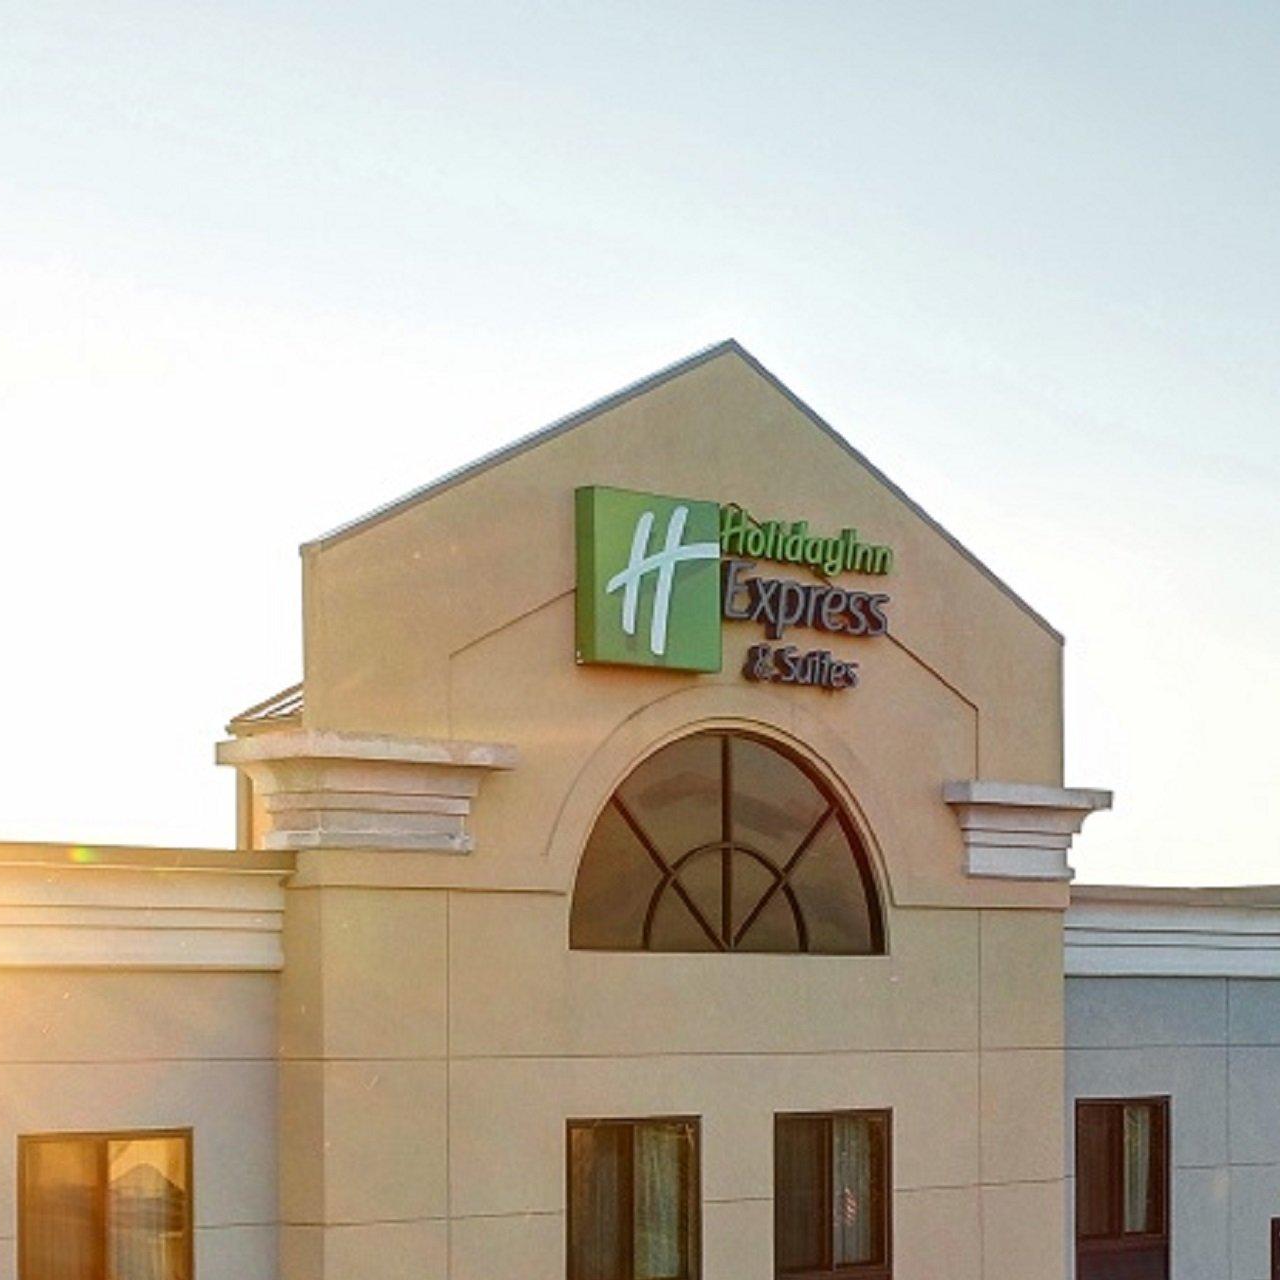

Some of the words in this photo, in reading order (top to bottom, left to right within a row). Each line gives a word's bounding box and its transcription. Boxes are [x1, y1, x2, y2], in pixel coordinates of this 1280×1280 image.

[723, 559, 890, 639] Express
[750, 643, 776, 681] &
[778, 645, 859, 689] Suites
